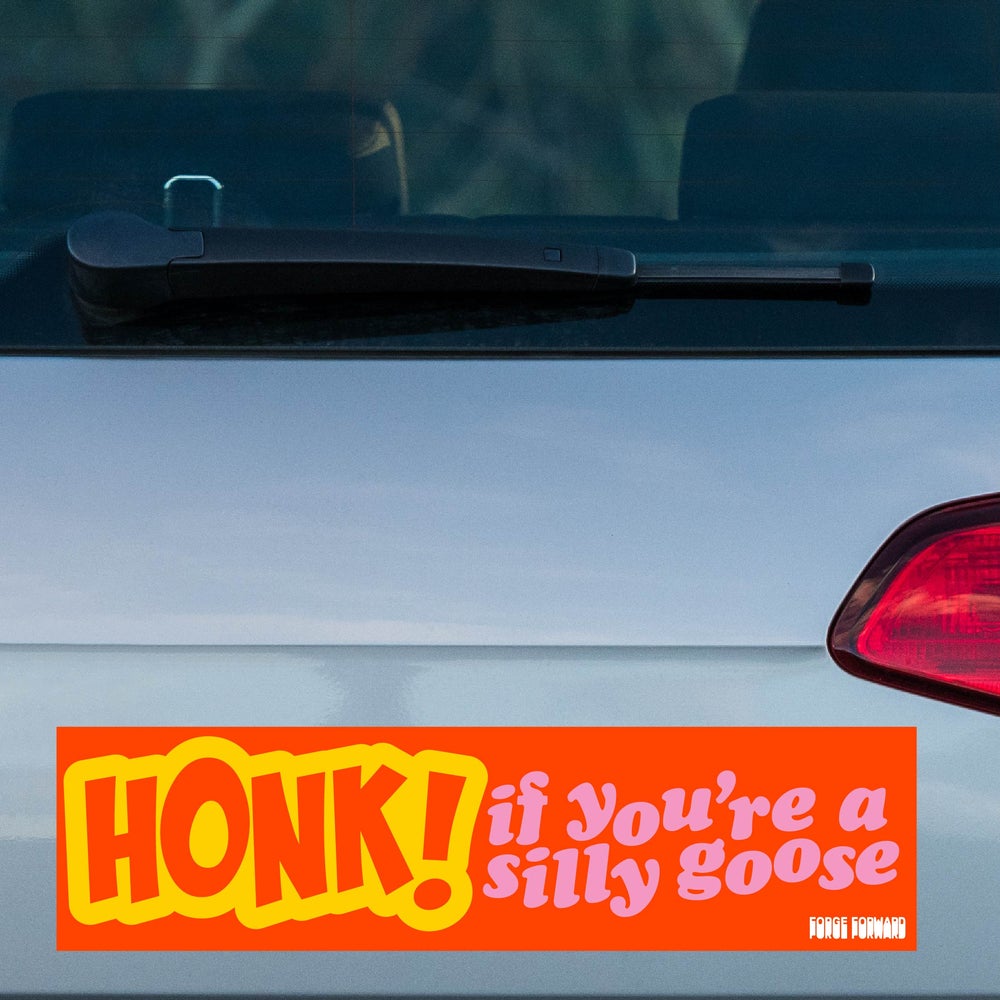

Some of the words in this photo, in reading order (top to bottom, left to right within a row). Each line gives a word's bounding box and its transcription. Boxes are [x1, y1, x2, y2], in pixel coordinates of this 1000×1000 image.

[82, 755, 468, 912] HONK!
[487, 771, 549, 846] if
[566, 770, 816, 847] you’re
[838, 787, 888, 832] a
[482, 843, 660, 918] silly
[677, 838, 900, 901] goose
[809, 916, 848, 940] FORGE
[851, 916, 906, 940] FORWARD
